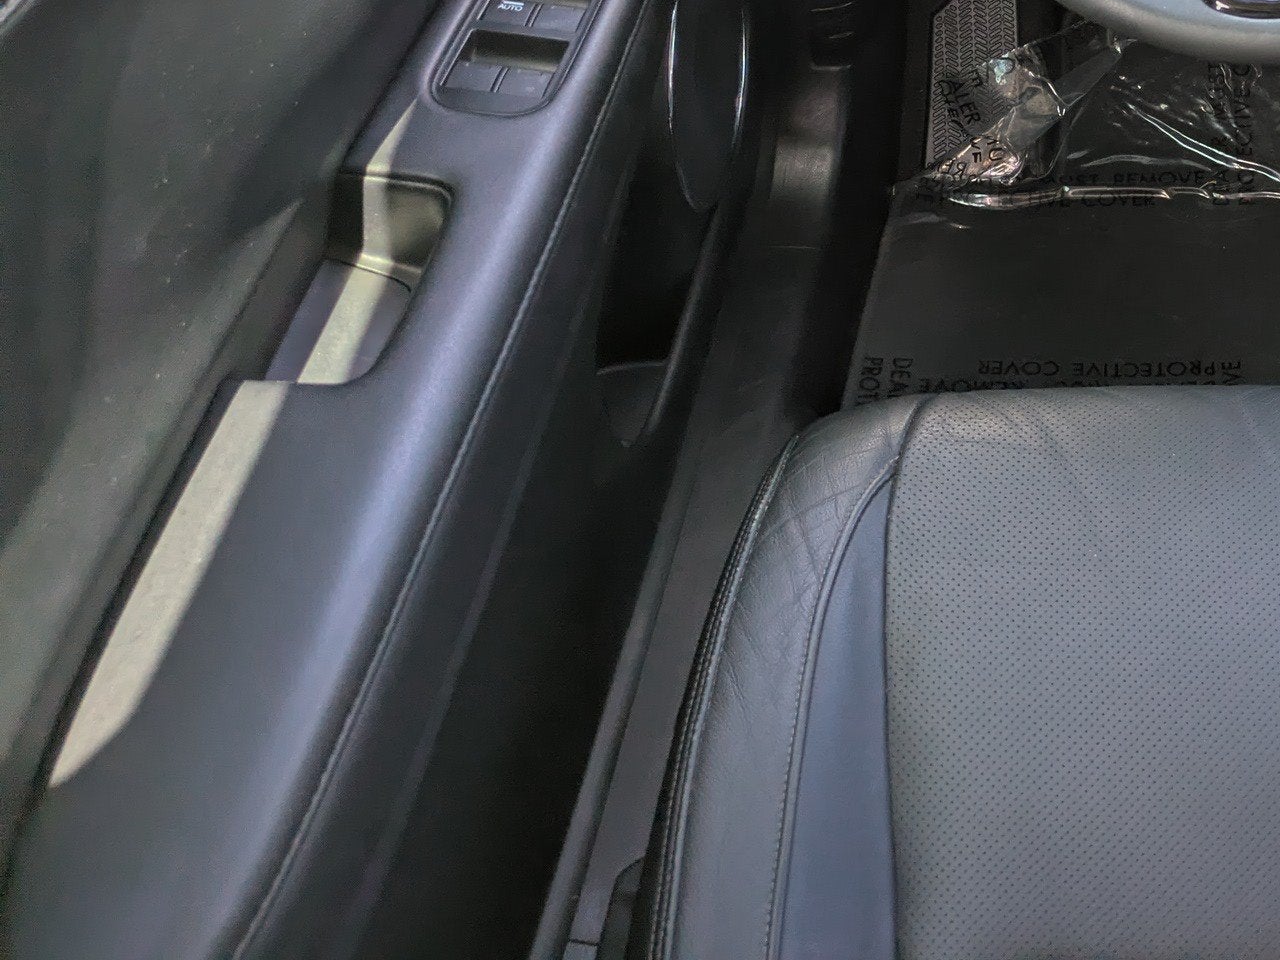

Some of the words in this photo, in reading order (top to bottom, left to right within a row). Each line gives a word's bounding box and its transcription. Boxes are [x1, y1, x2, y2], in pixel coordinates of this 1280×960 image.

[497, 3, 524, 12] AUTO
[977, 360, 1060, 377] COVER
[1071, 360, 1216, 378] PROTECTIVE
